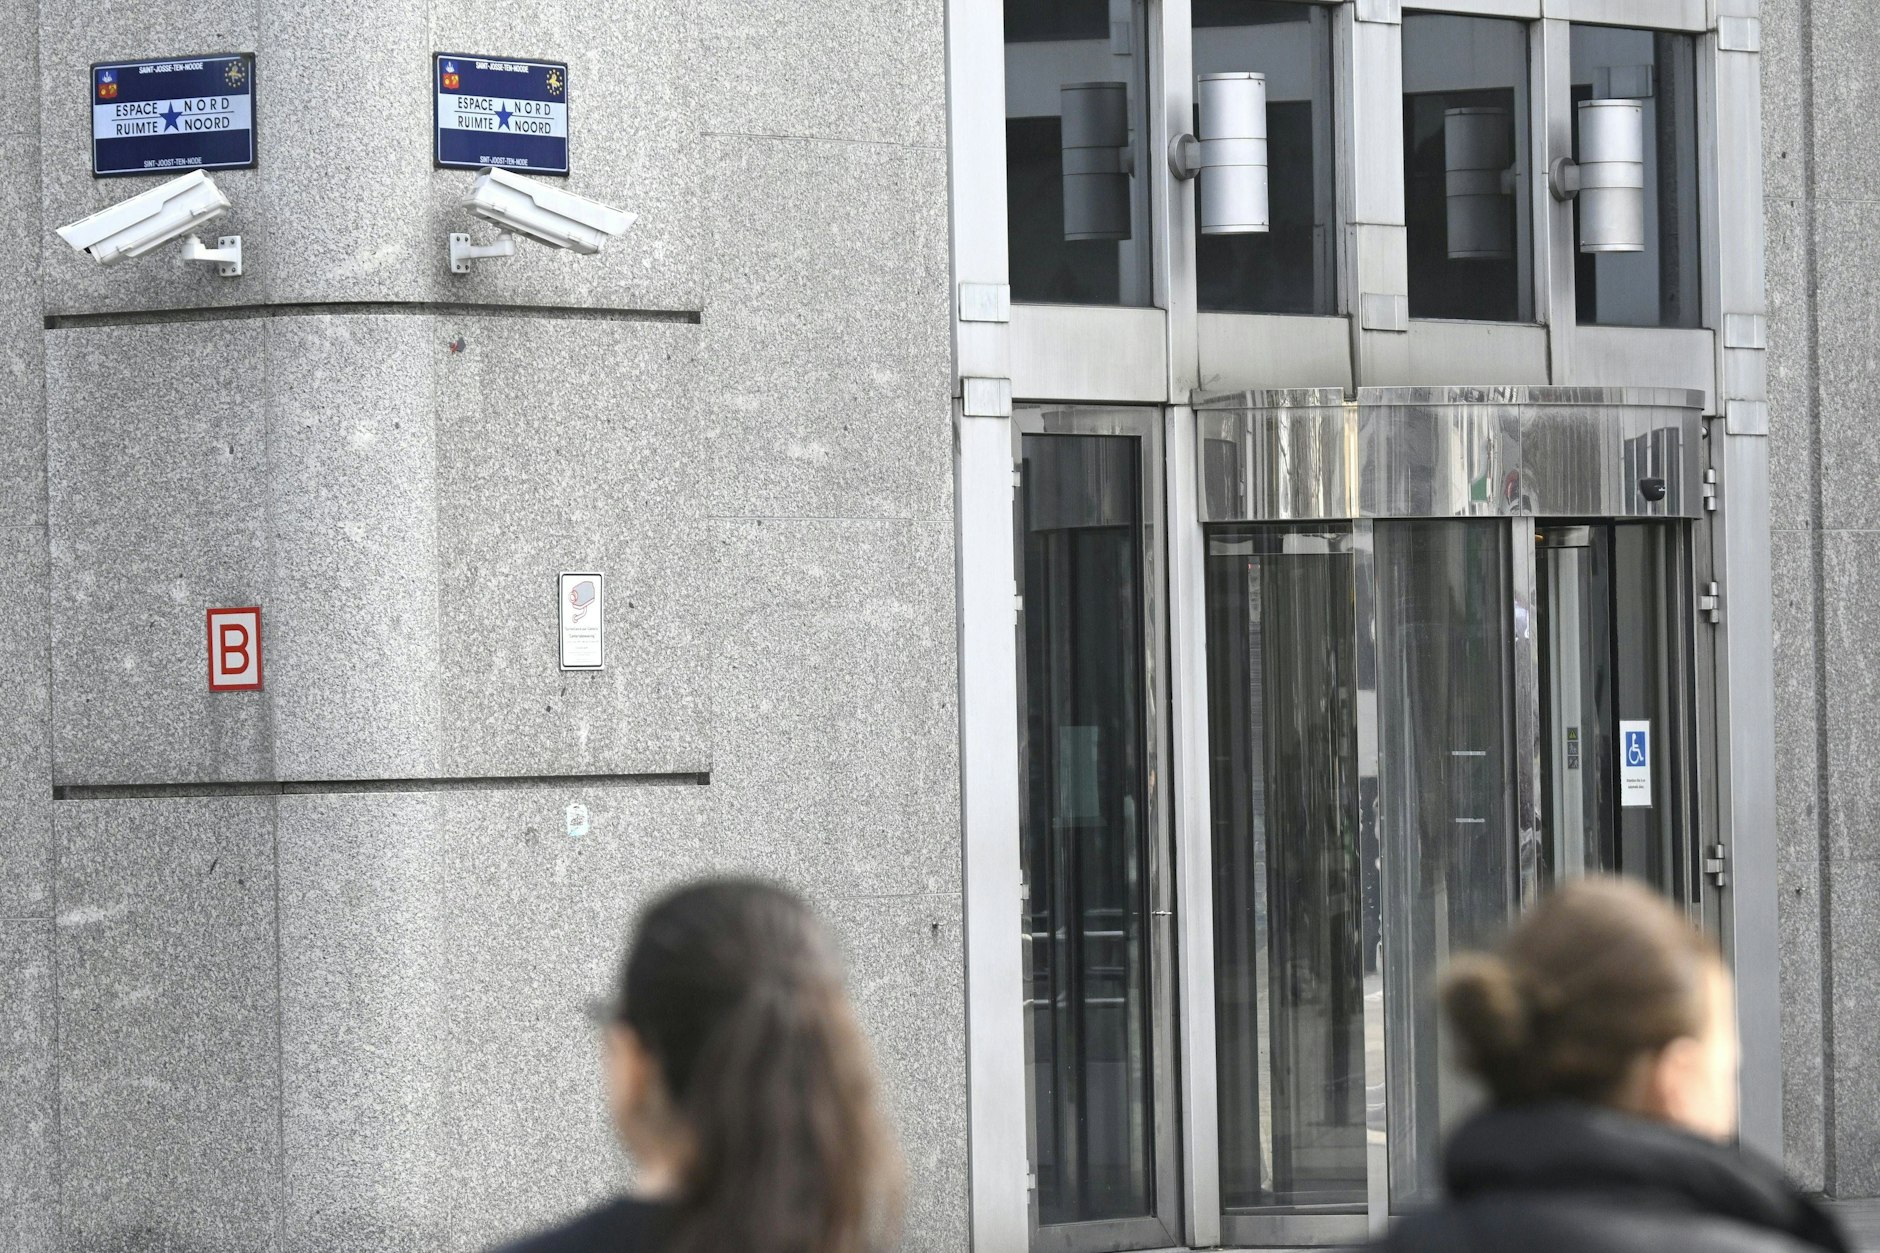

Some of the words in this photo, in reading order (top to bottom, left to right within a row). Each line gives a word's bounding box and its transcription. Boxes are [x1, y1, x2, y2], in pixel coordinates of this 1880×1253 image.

[139, 62, 203, 74] SAINT-JOSSE-TEN-NOODE
[116, 102, 158, 117] ESPACE
[184, 97, 230, 112] NORD
[458, 97, 493, 111] ESPACE
[514, 101, 551, 115] NORD
[116, 121, 158, 136] RUIMTE
[184, 116, 230, 131] NOORD
[458, 116, 493, 130] RUIMTE
[515, 120, 552, 134] NOORD
[220, 623, 249, 675] B
